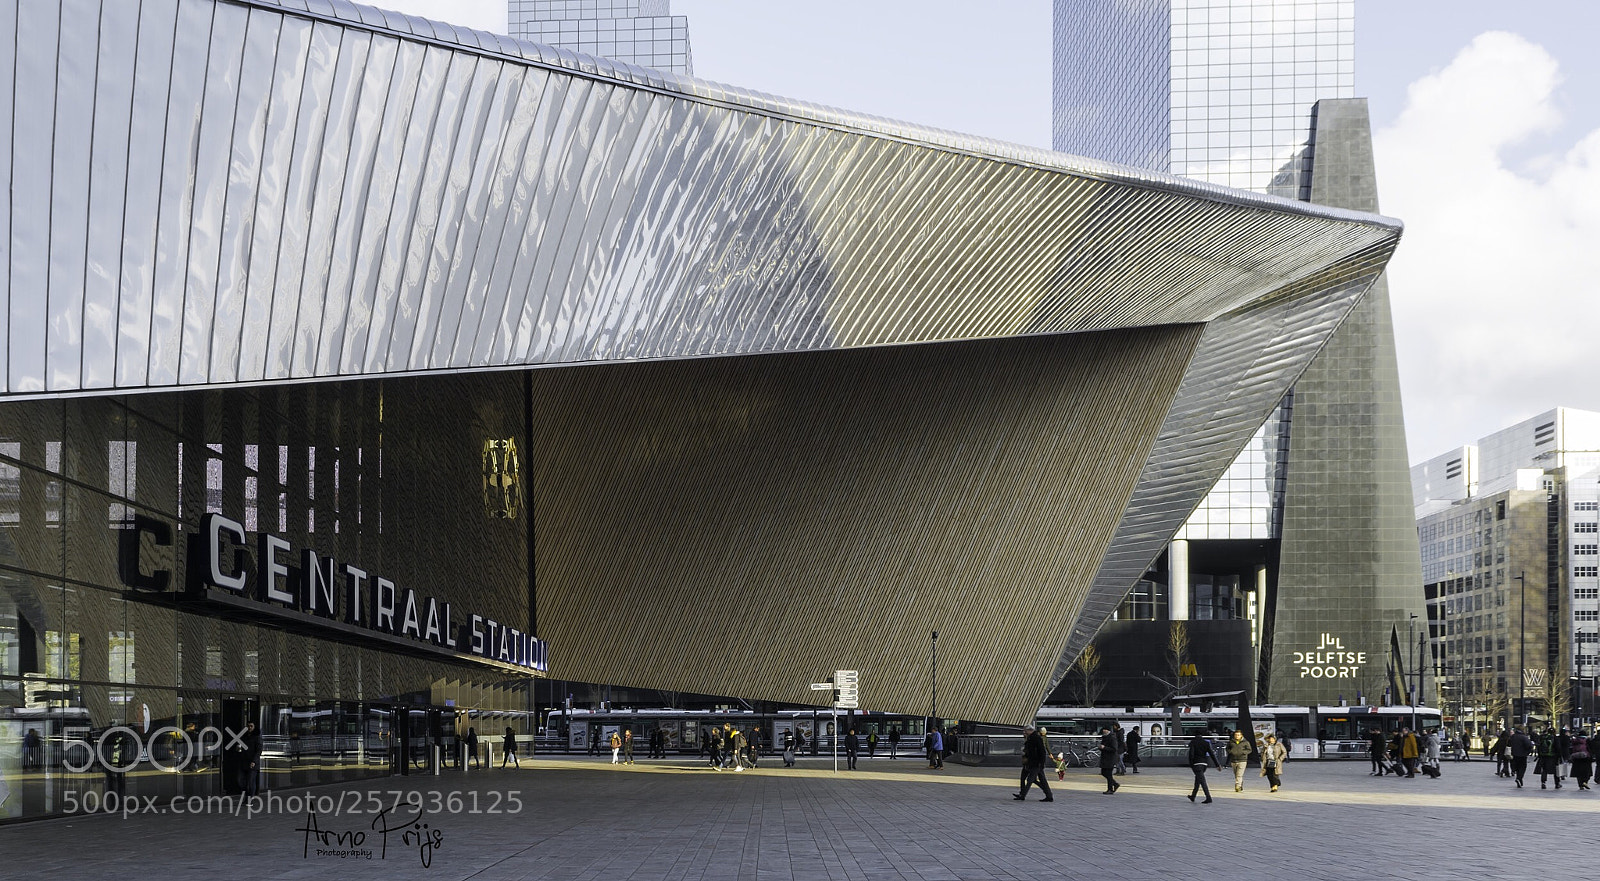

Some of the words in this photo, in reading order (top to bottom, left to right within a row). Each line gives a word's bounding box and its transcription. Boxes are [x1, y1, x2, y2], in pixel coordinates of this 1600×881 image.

[204, 512, 456, 647] CENTRAAL
[470, 613, 549, 671] STATION
[1293, 652, 1366, 664] DELFTSE
[1300, 666, 1359, 678] POORT
